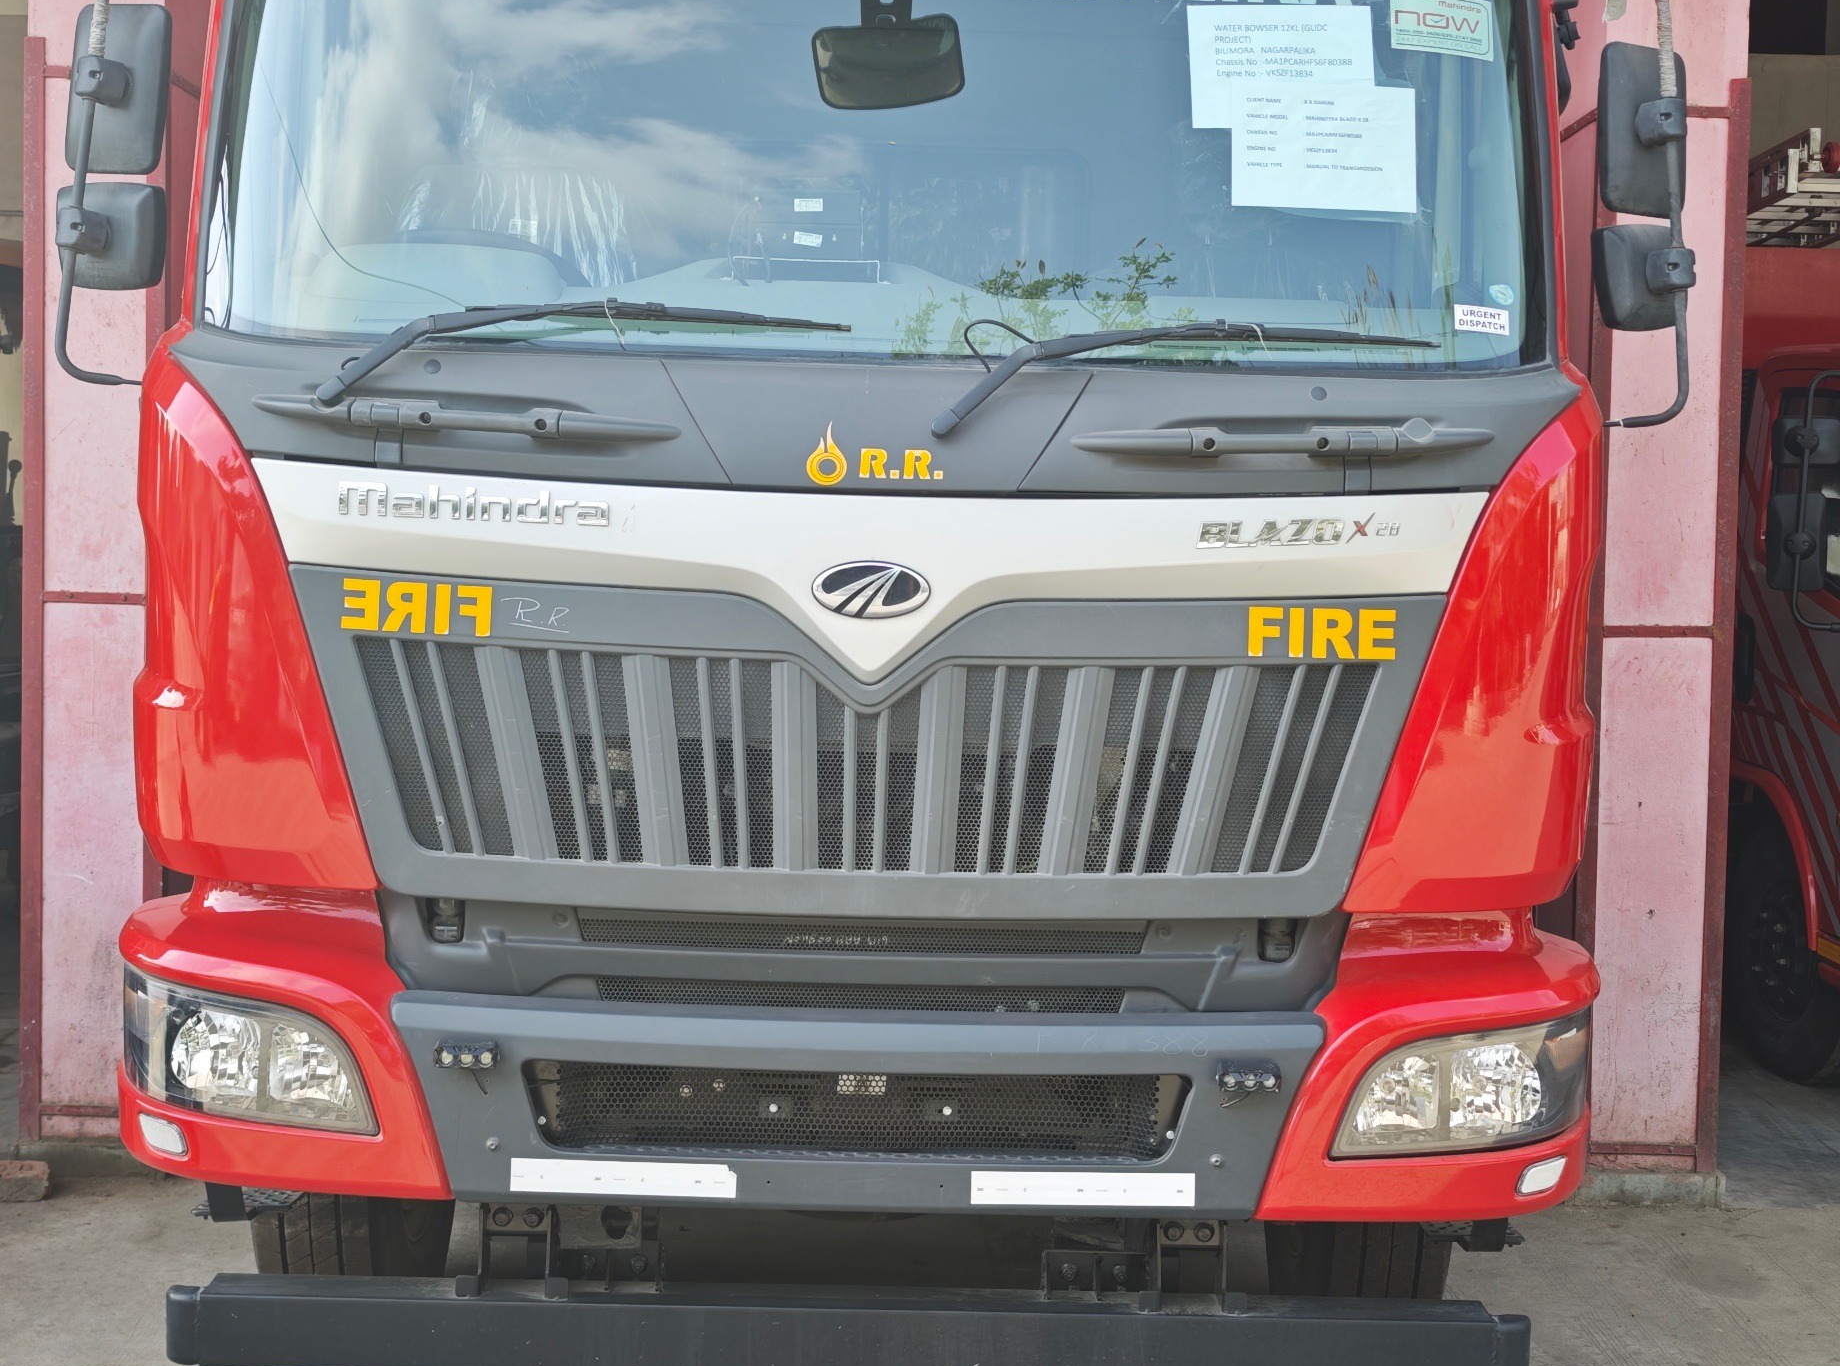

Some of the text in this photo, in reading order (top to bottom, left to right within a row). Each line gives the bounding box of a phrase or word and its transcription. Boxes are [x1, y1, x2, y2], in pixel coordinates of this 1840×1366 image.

[1214, 24, 1328, 33] WATER BOWSER 12KL (GUDC
[1214, 36, 1252, 44] PROJECT)
[1417, 37, 1448, 46] EXPERT
[1215, 47, 1255, 55] BILIMORA
[1215, 58, 1244, 66] Chassis
[1246, 58, 1258, 66] No
[1216, 69, 1243, 78] Engine
[1462, 308, 1502, 321] URGENT
[1458, 318, 1506, 332] DISPATCH
[338, 480, 610, 527] Mahindra
[1195, 517, 1345, 549] BLAZO
[1346, 512, 1376, 544] X
[1247, 606, 1397, 660] FIRE
